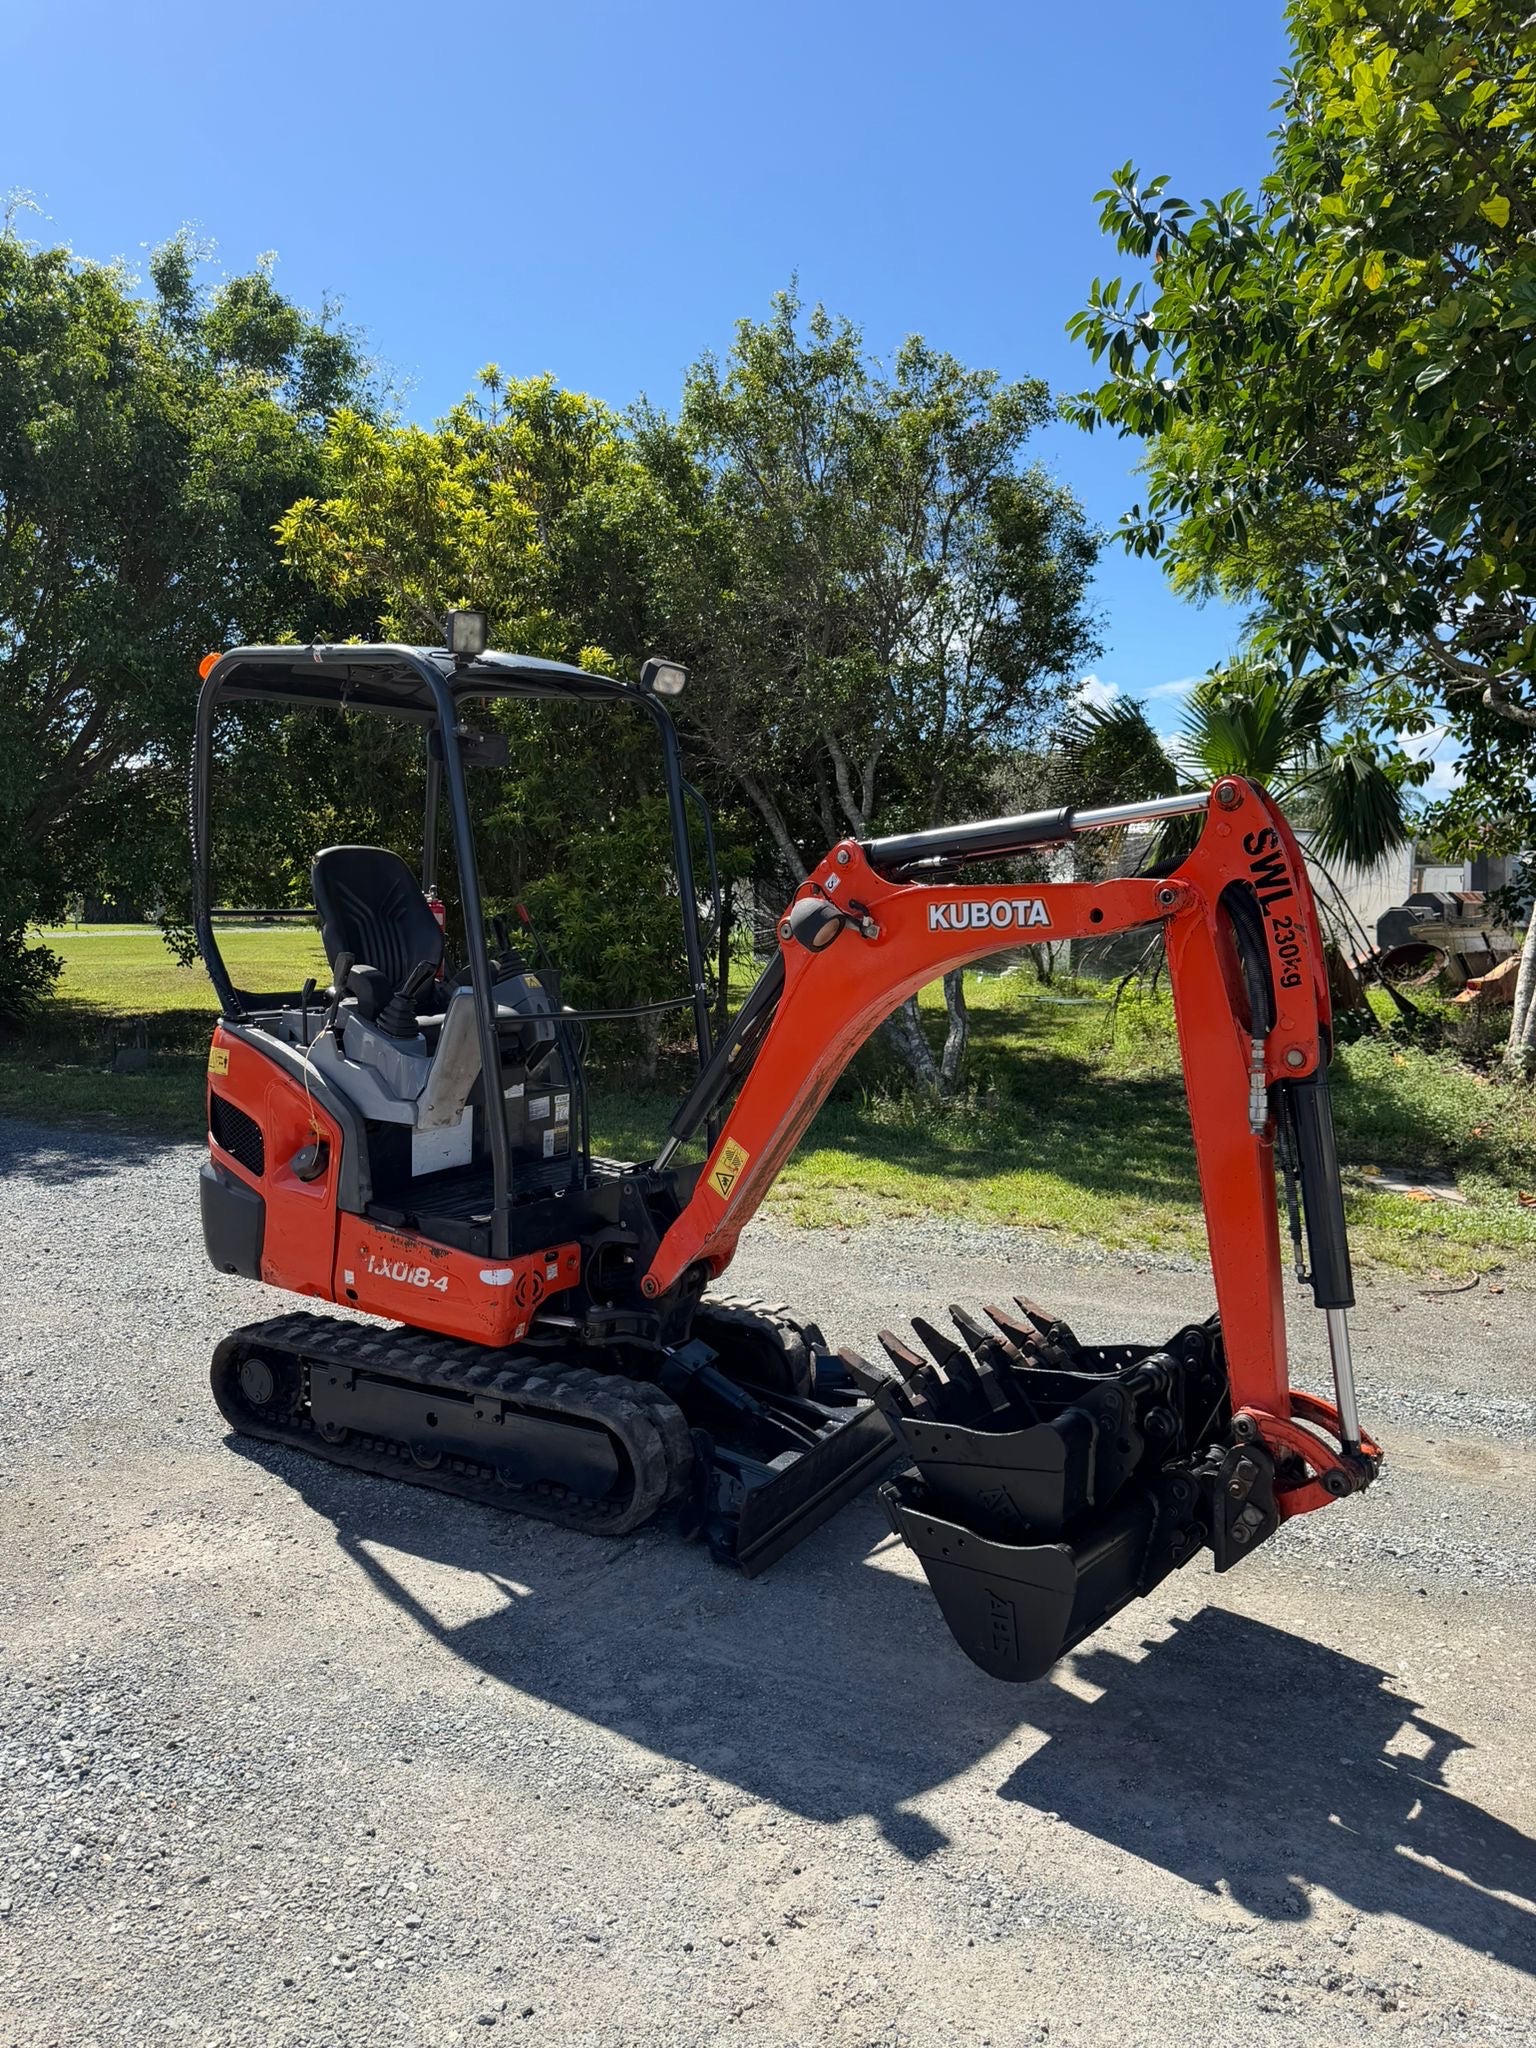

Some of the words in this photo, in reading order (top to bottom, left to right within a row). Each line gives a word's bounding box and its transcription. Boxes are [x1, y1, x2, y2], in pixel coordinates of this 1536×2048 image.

[928, 899, 1051, 930] KUBOTA
[1243, 827, 1293, 917] SWL
[1272, 915, 1302, 989] 230kg
